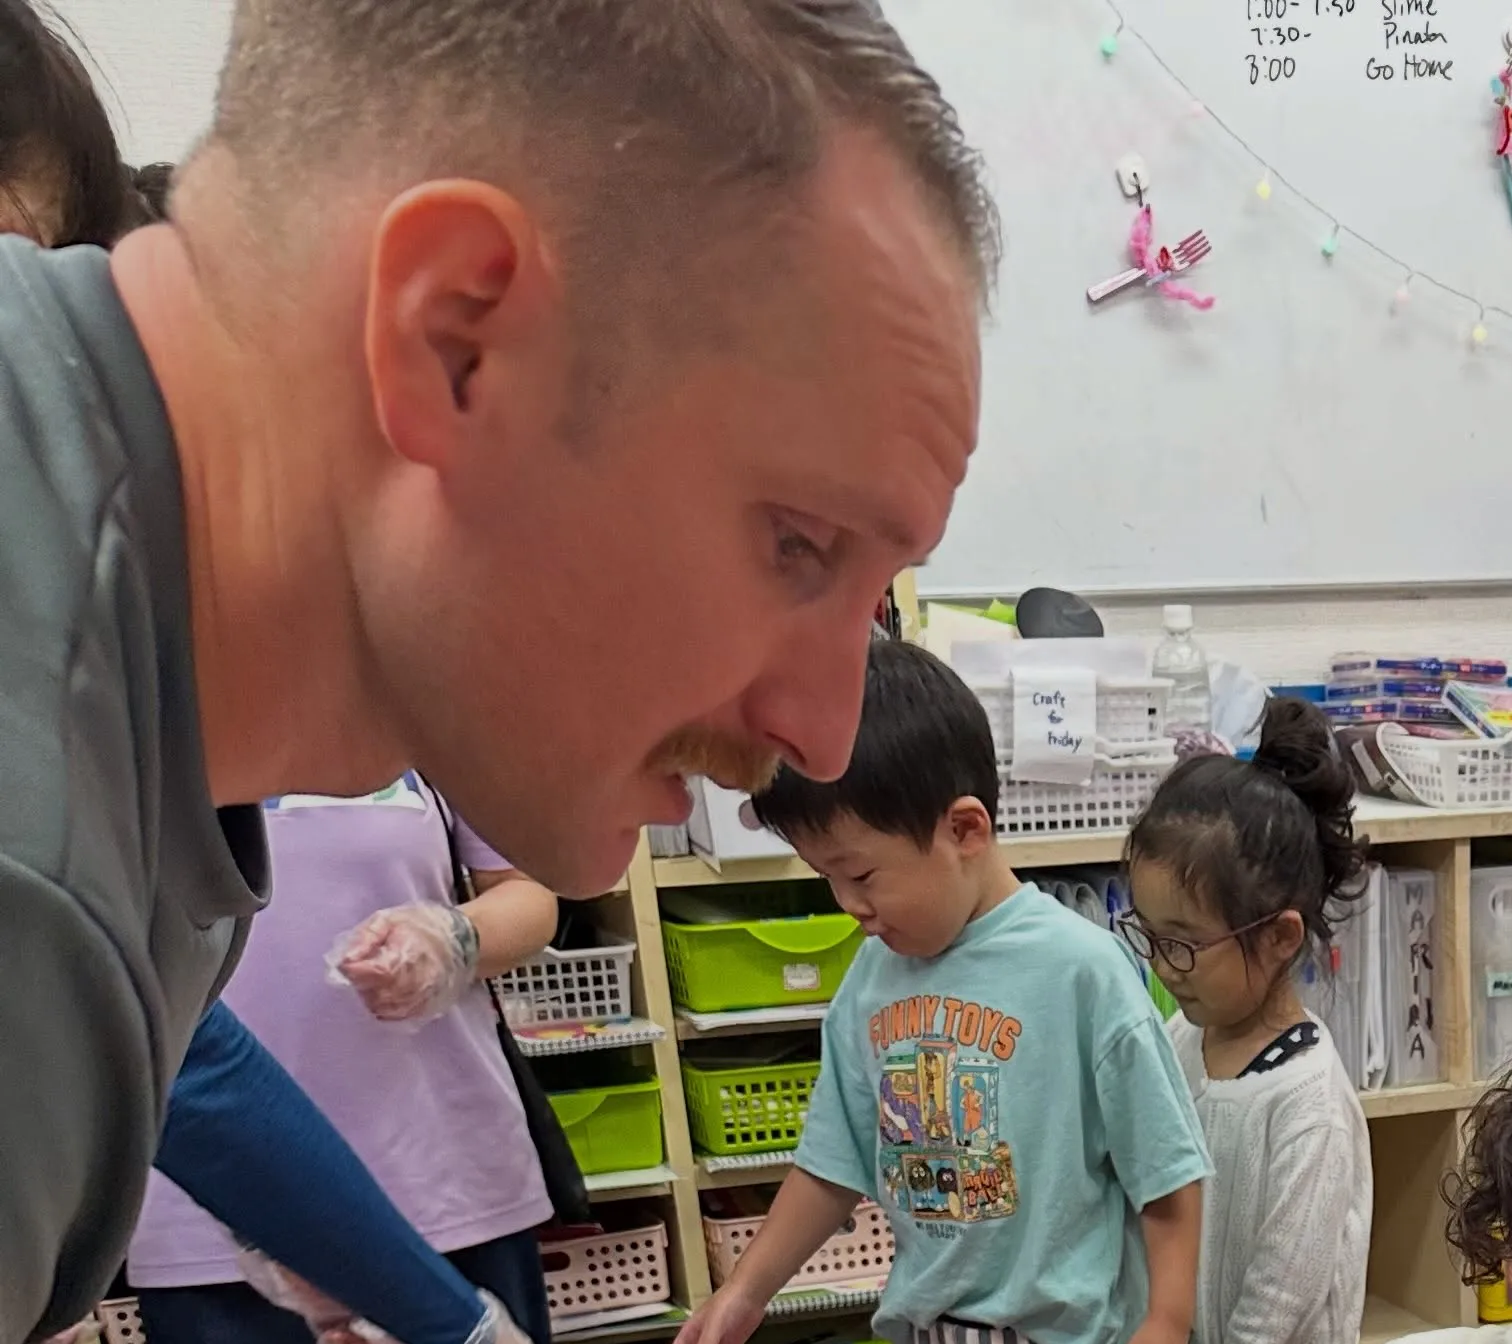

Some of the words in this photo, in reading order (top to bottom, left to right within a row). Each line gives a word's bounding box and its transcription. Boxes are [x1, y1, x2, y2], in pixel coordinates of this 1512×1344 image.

[1245, 54, 1296, 84] 8:00
[1366, 57, 1394, 80] Go
[1404, 52, 1453, 81] Home
[1047, 730, 1083, 754] Friday
[869, 995, 940, 1059] FUNNY
[943, 996, 1022, 1061] TOYS
